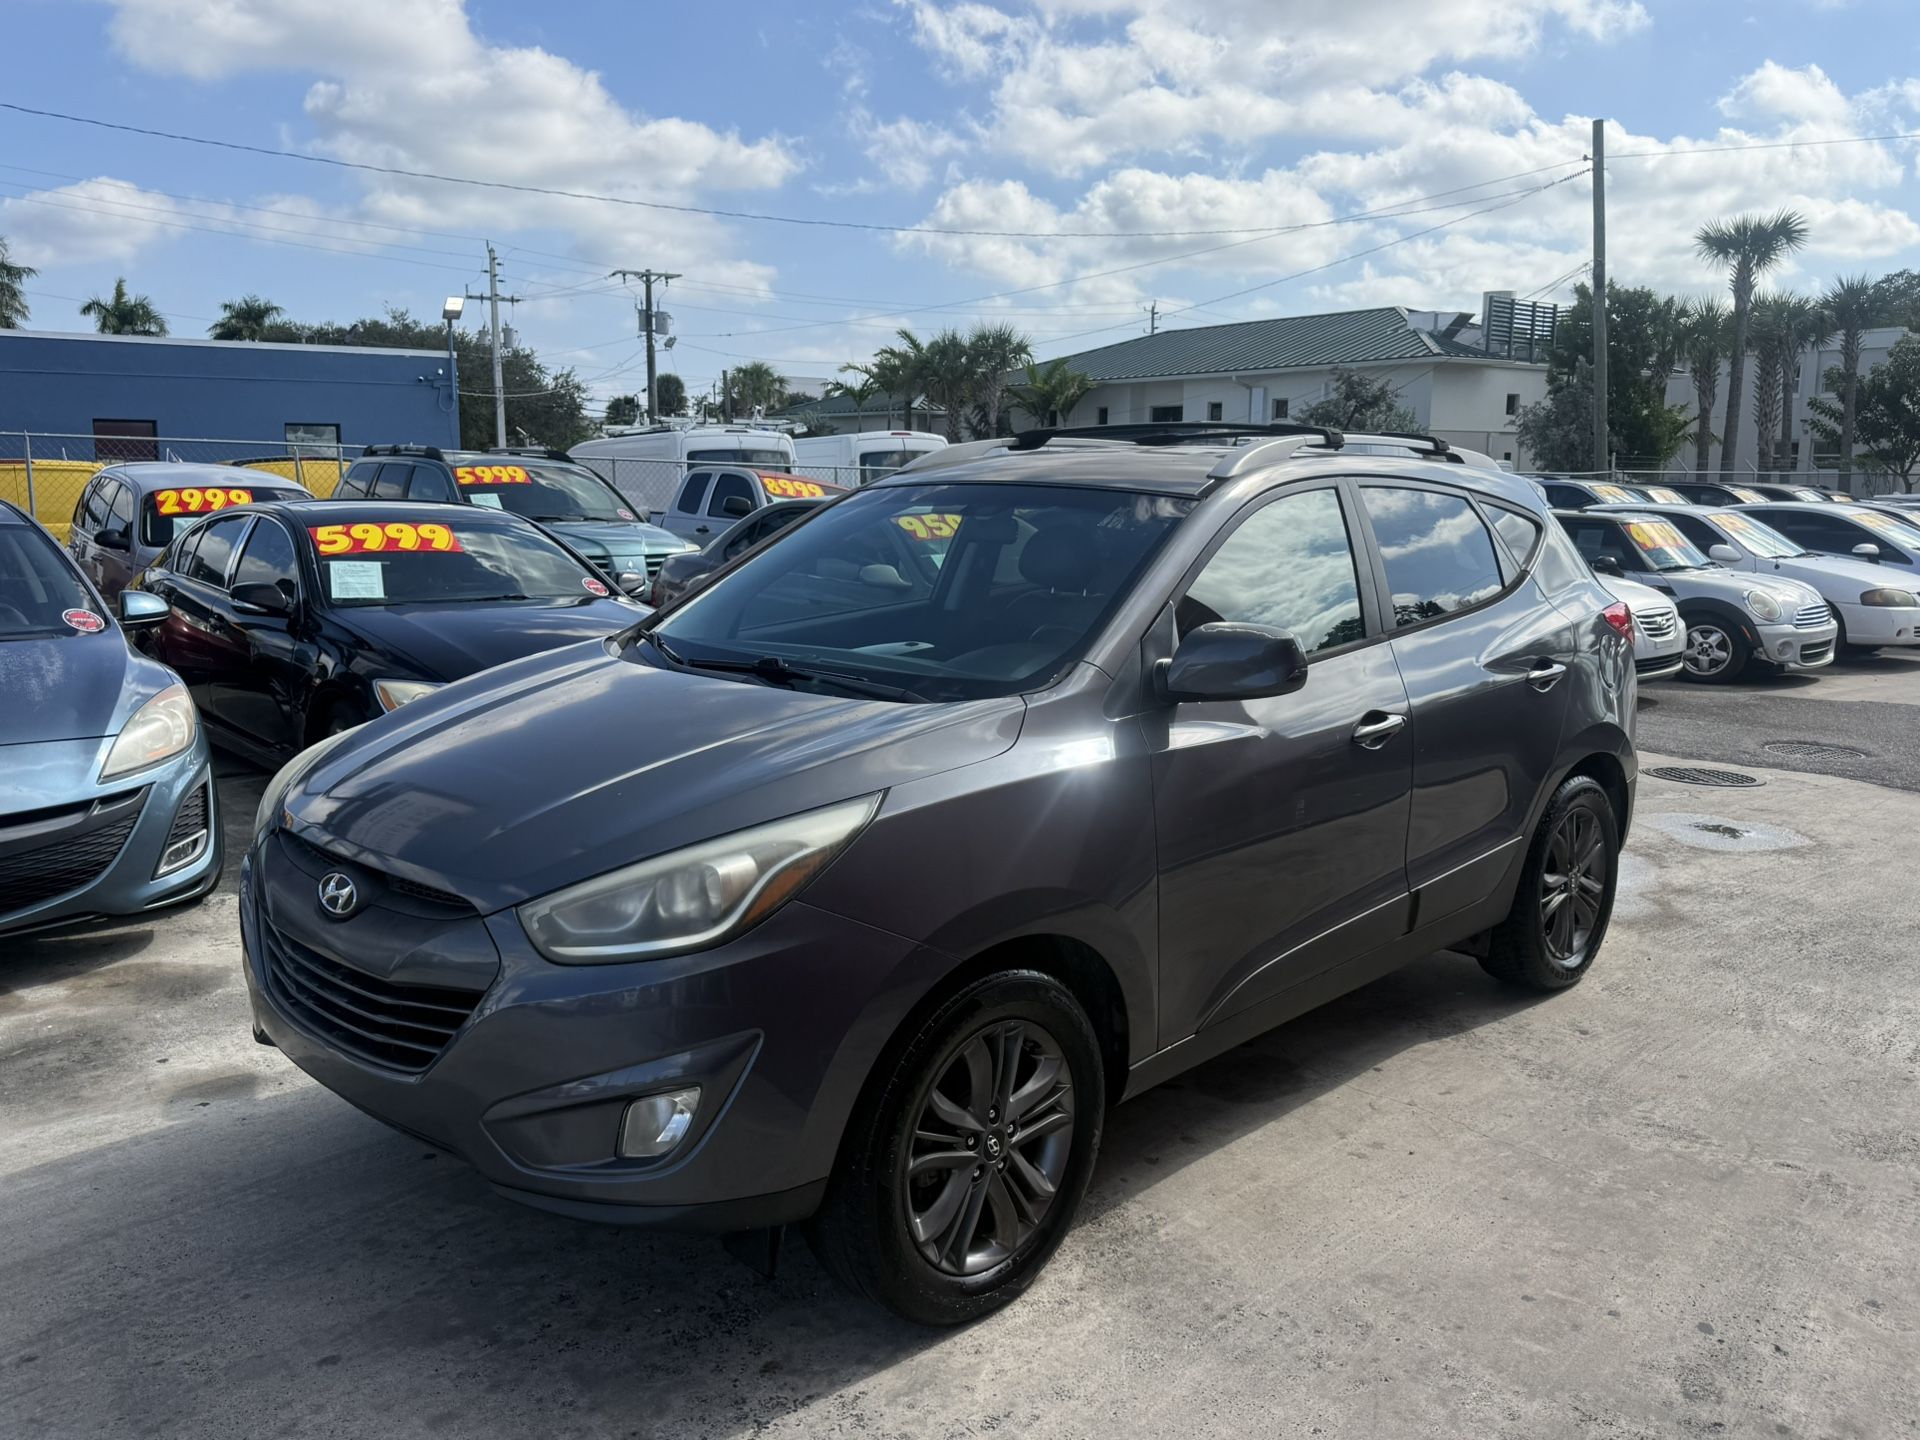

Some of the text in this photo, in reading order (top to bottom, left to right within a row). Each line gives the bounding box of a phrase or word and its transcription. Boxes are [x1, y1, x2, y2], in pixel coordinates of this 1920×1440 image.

[456, 466, 527, 484] 5999
[763, 477, 825, 497] 8999
[157, 488, 253, 514] 2999
[316, 523, 453, 554] 5999
